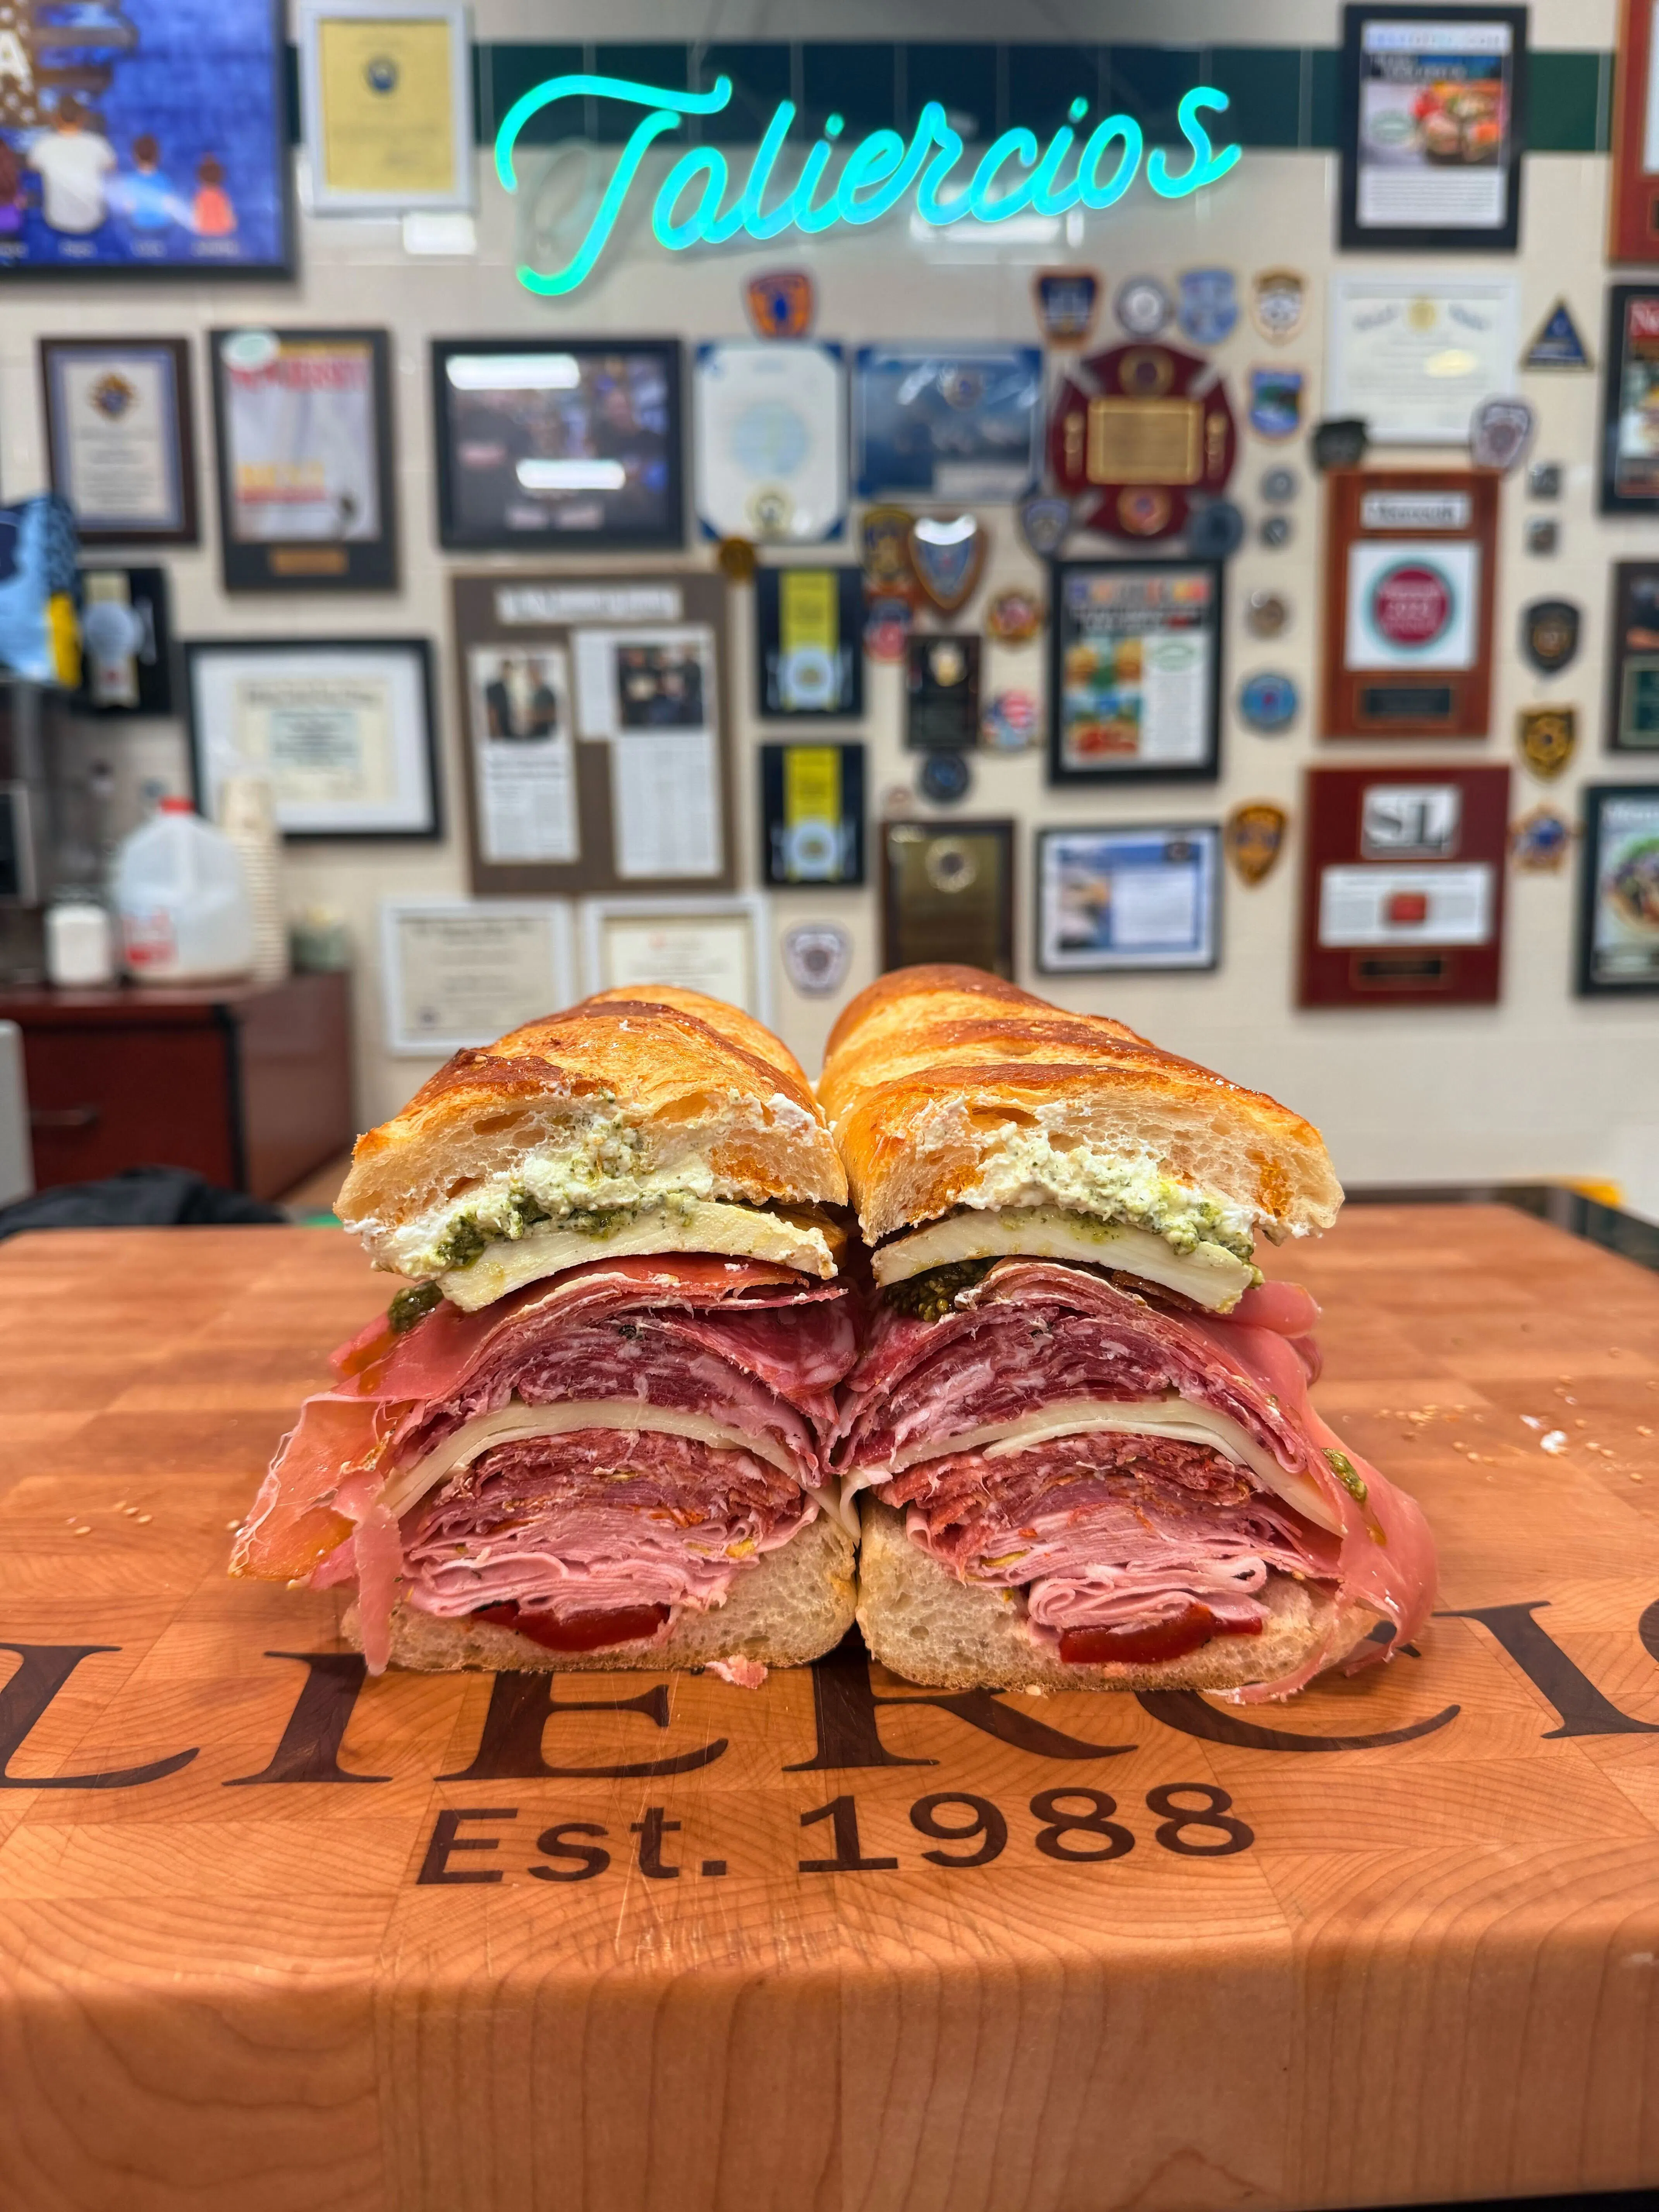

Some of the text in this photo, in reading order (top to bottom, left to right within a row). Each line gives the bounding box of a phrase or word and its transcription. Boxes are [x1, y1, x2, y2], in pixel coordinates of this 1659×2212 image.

[494, 74, 1242, 296] Taliercios
[0, 1599, 1659, 1788] LIERCI
[416, 1782, 1255, 1885] Est. 1988
